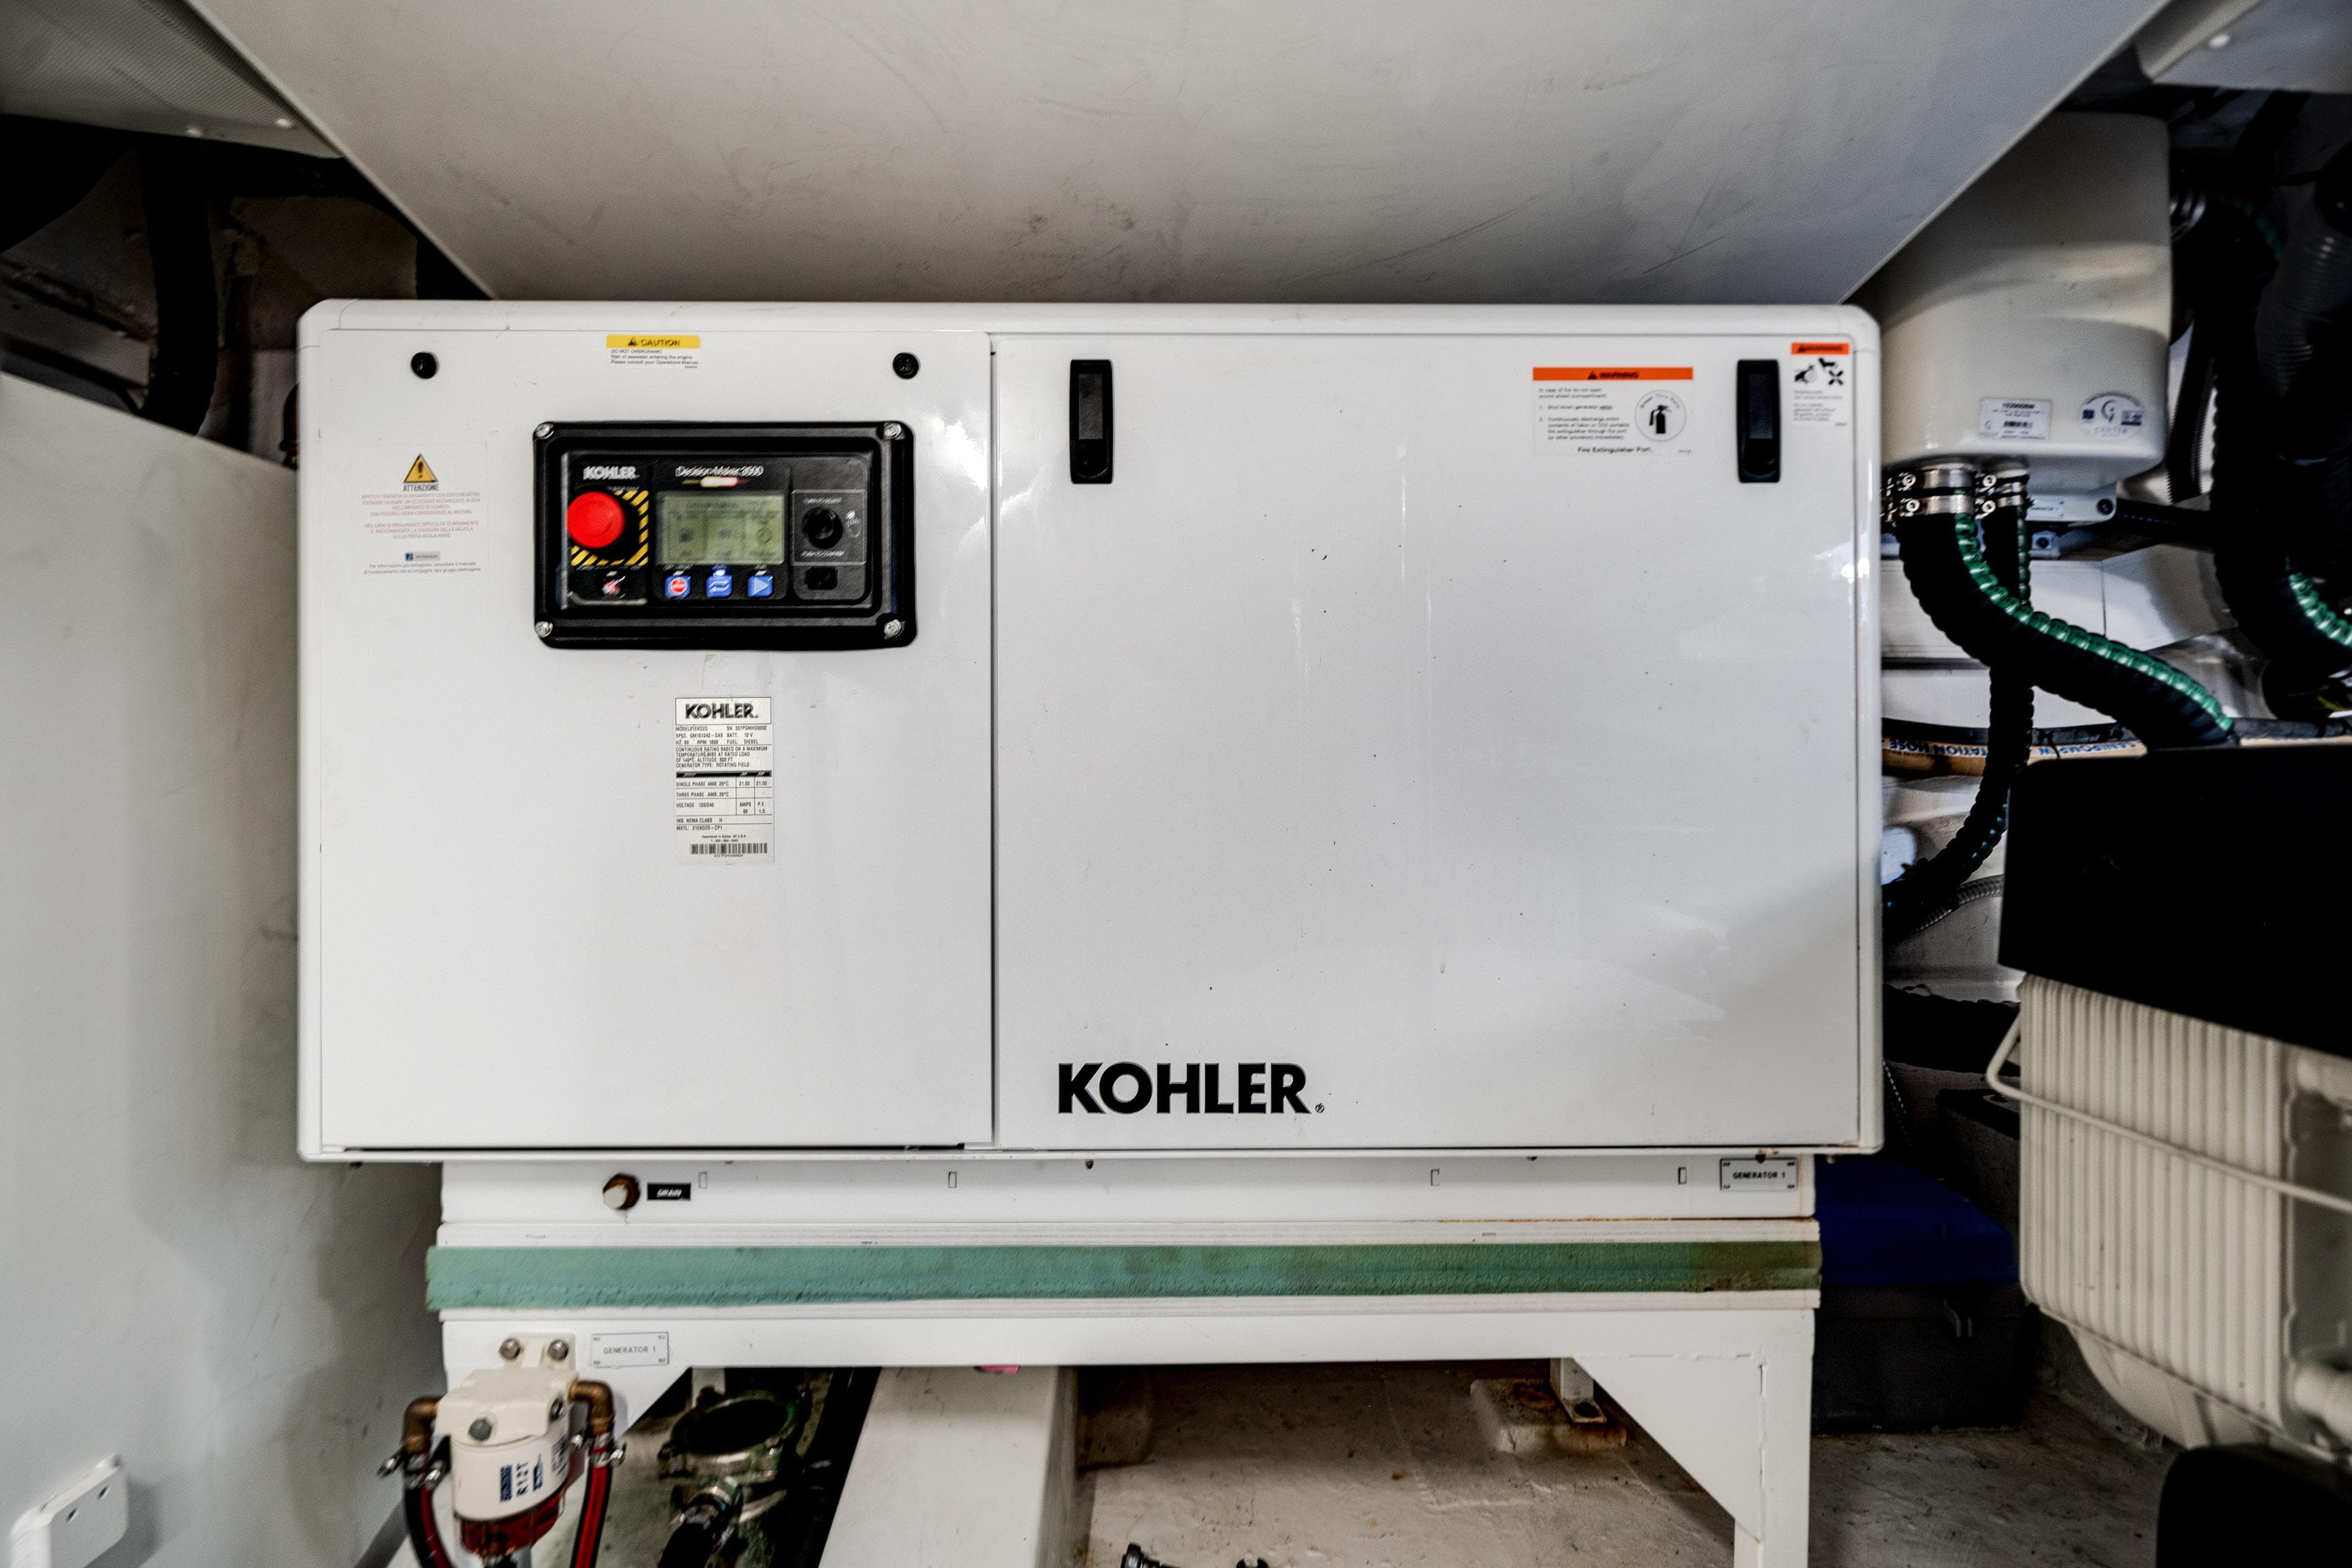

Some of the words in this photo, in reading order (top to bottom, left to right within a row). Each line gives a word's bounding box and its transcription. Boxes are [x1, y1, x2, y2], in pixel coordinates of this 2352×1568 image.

[583, 466, 637, 480] KOHLER
[685, 703, 755, 719] KOHLER
[1888, 739, 1930, 755] HOSE
[1933, 745, 1988, 757] TATION
[1058, 1061, 1311, 1114] KOHLER
